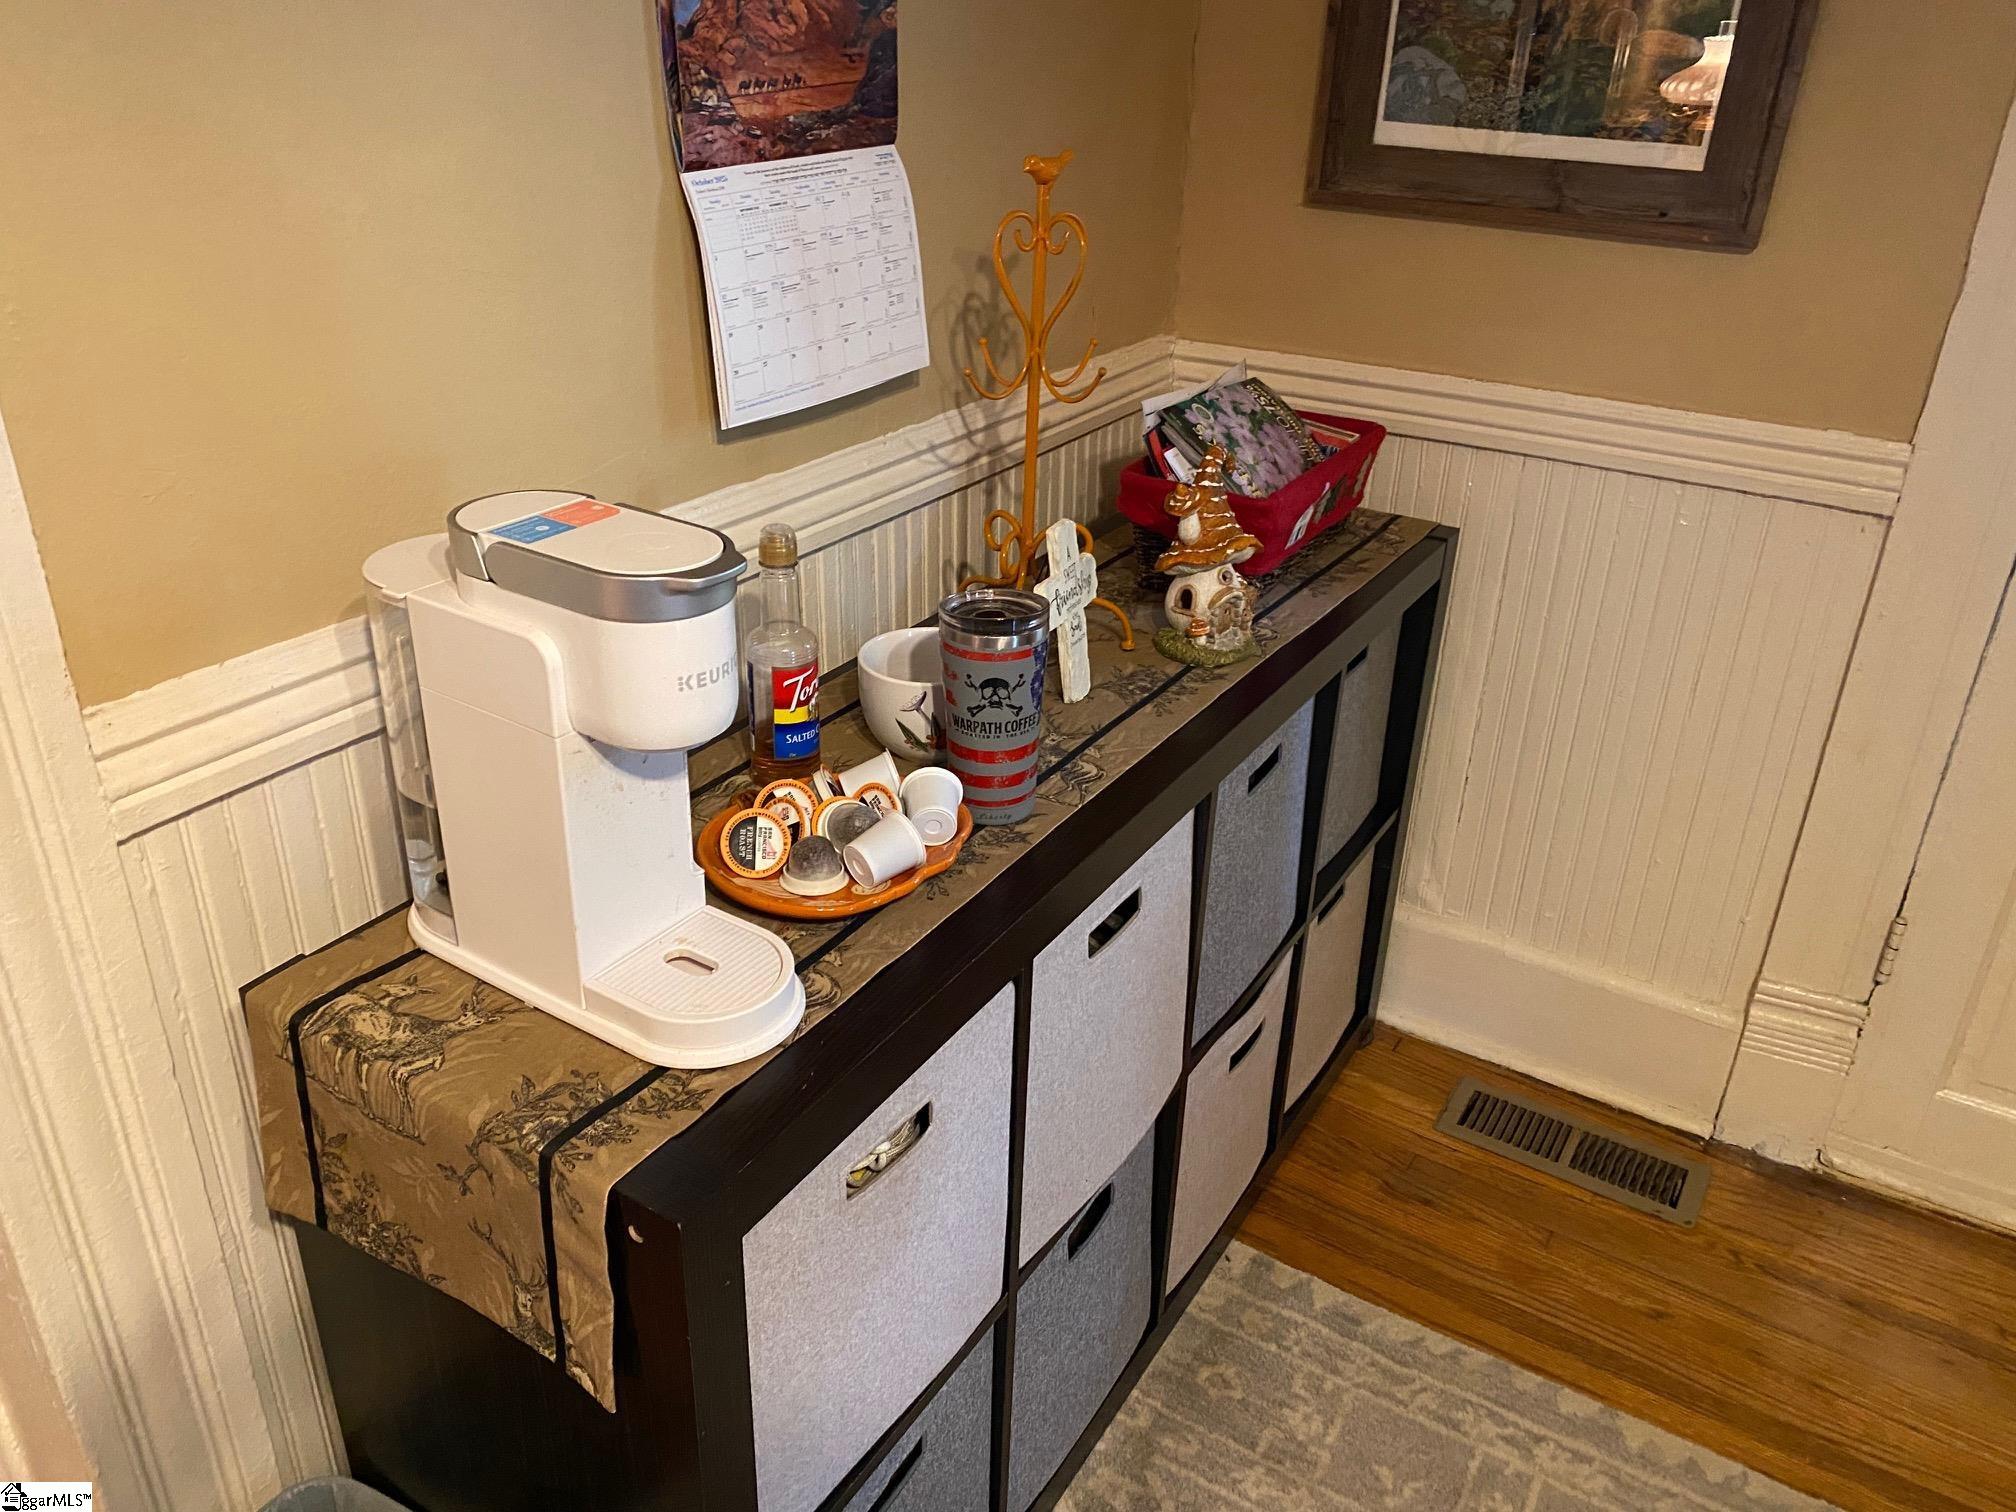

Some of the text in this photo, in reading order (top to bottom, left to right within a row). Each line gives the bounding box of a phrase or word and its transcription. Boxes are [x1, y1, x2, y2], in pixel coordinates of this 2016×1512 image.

[786, 729, 816, 744] SALTED
[951, 713, 1003, 735] WARPATH
[738, 828, 747, 858] ROAST
[745, 825, 753, 860] FRENCH
